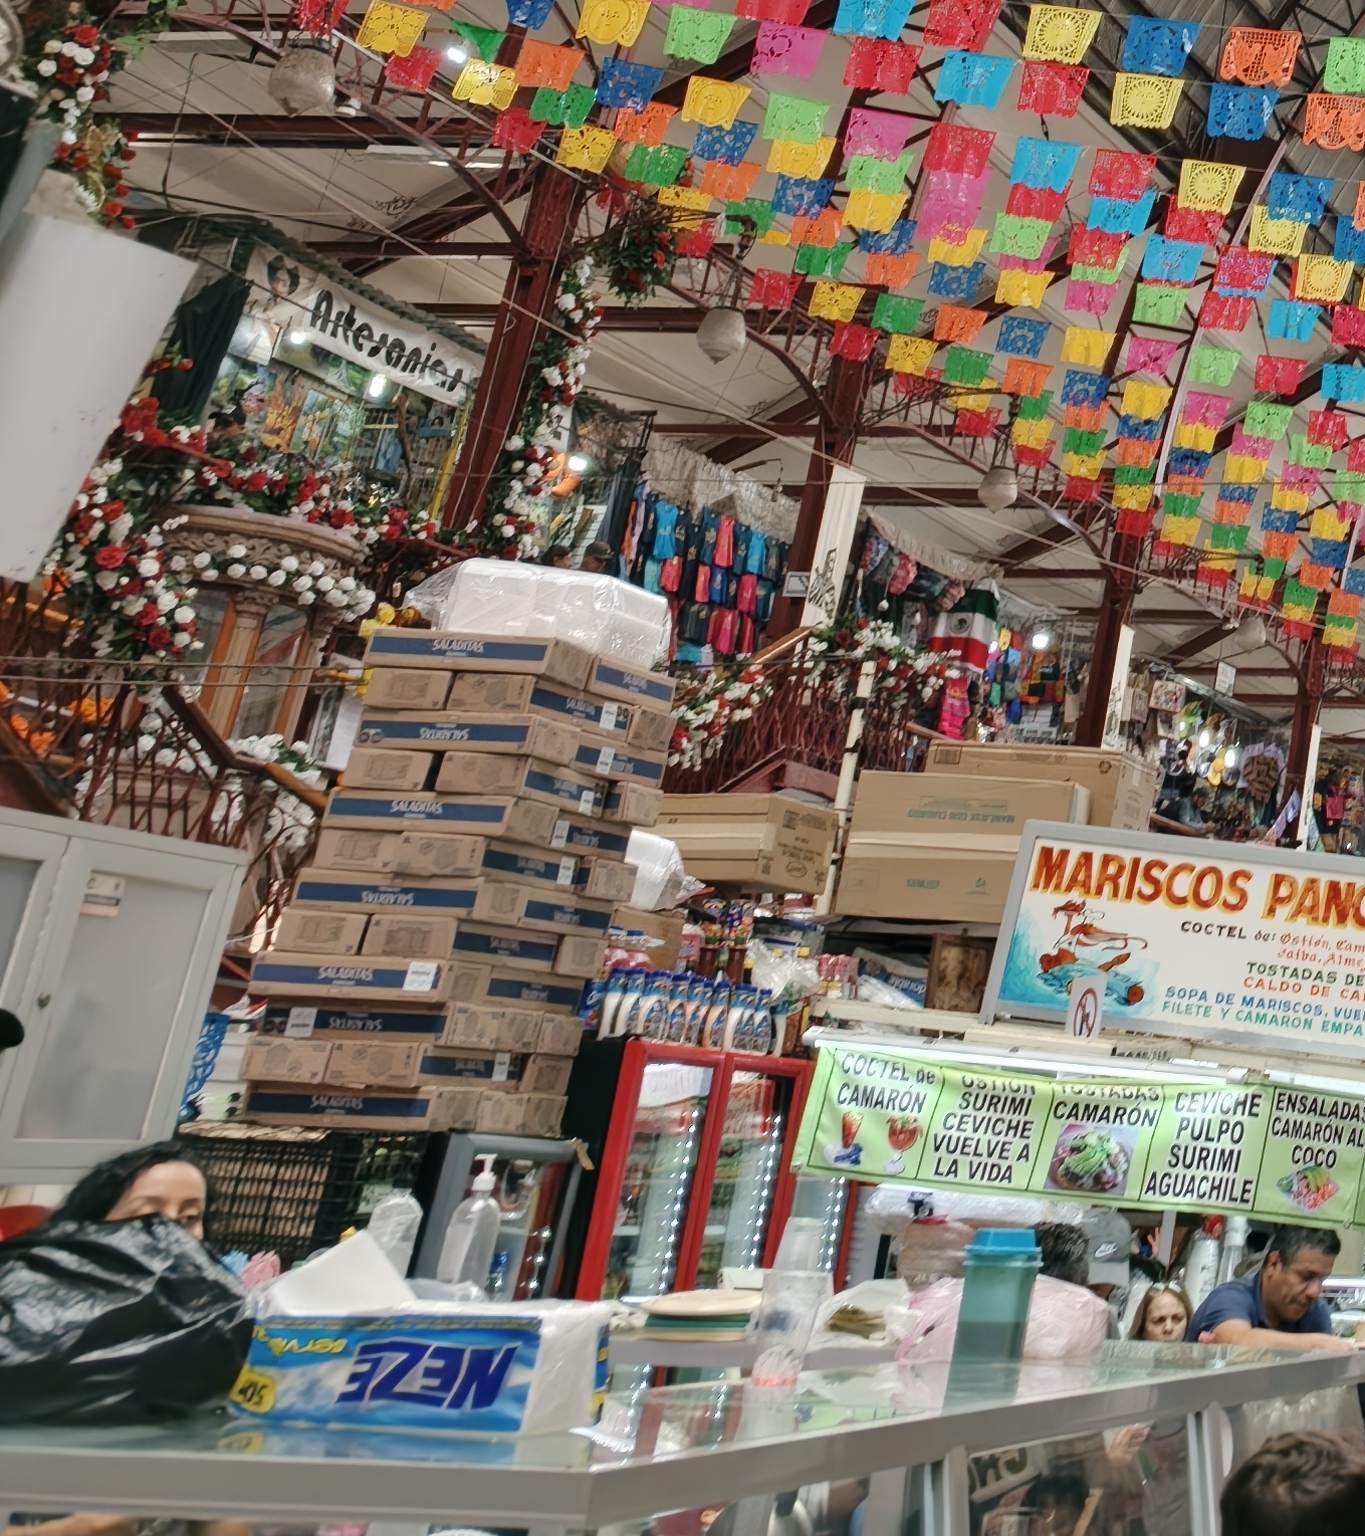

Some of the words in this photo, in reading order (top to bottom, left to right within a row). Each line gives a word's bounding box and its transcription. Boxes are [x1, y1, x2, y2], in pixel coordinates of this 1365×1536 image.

[1028, 846, 1254, 914] MARISCOS
[1181, 920, 1247, 940] COCTEL
[1244, 977, 1302, 993] CALDO
[1310, 983, 1330, 998] DE
[1247, 962, 1337, 984] TOSTADAS
[1345, 973, 1364, 987] DE
[1165, 986, 1208, 1002] SOPA
[1215, 992, 1235, 1005] DE
[1162, 1001, 1212, 1018] FILETE
[1220, 1007, 1232, 1019] Y
[1235, 1010, 1313, 1030] CAMARON
[841, 1052, 911, 1082] COCTEL
[837, 1082, 928, 1114] CAMARÓN
[959, 1092, 1032, 1116] SURIMI
[1175, 1092, 1263, 1117] CEVICHE
[942, 1113, 1034, 1139] CEVICHE
[1052, 1101, 1158, 1127] CAMARÓN
[1176, 1117, 1244, 1144] PULPO
[1271, 1116, 1343, 1145] CAMARÓN
[1347, 1126, 1364, 1148] AL
[933, 1133, 1013, 1160] VUELVE
[1015, 1143, 1030, 1162] A
[1168, 1145, 1241, 1173] SURIMI
[1291, 1146, 1337, 1169] COCO
[934, 1157, 958, 1178] LA
[968, 1162, 1013, 1184] VIDA
[1144, 1171, 1254, 1204] AGUACHILE
